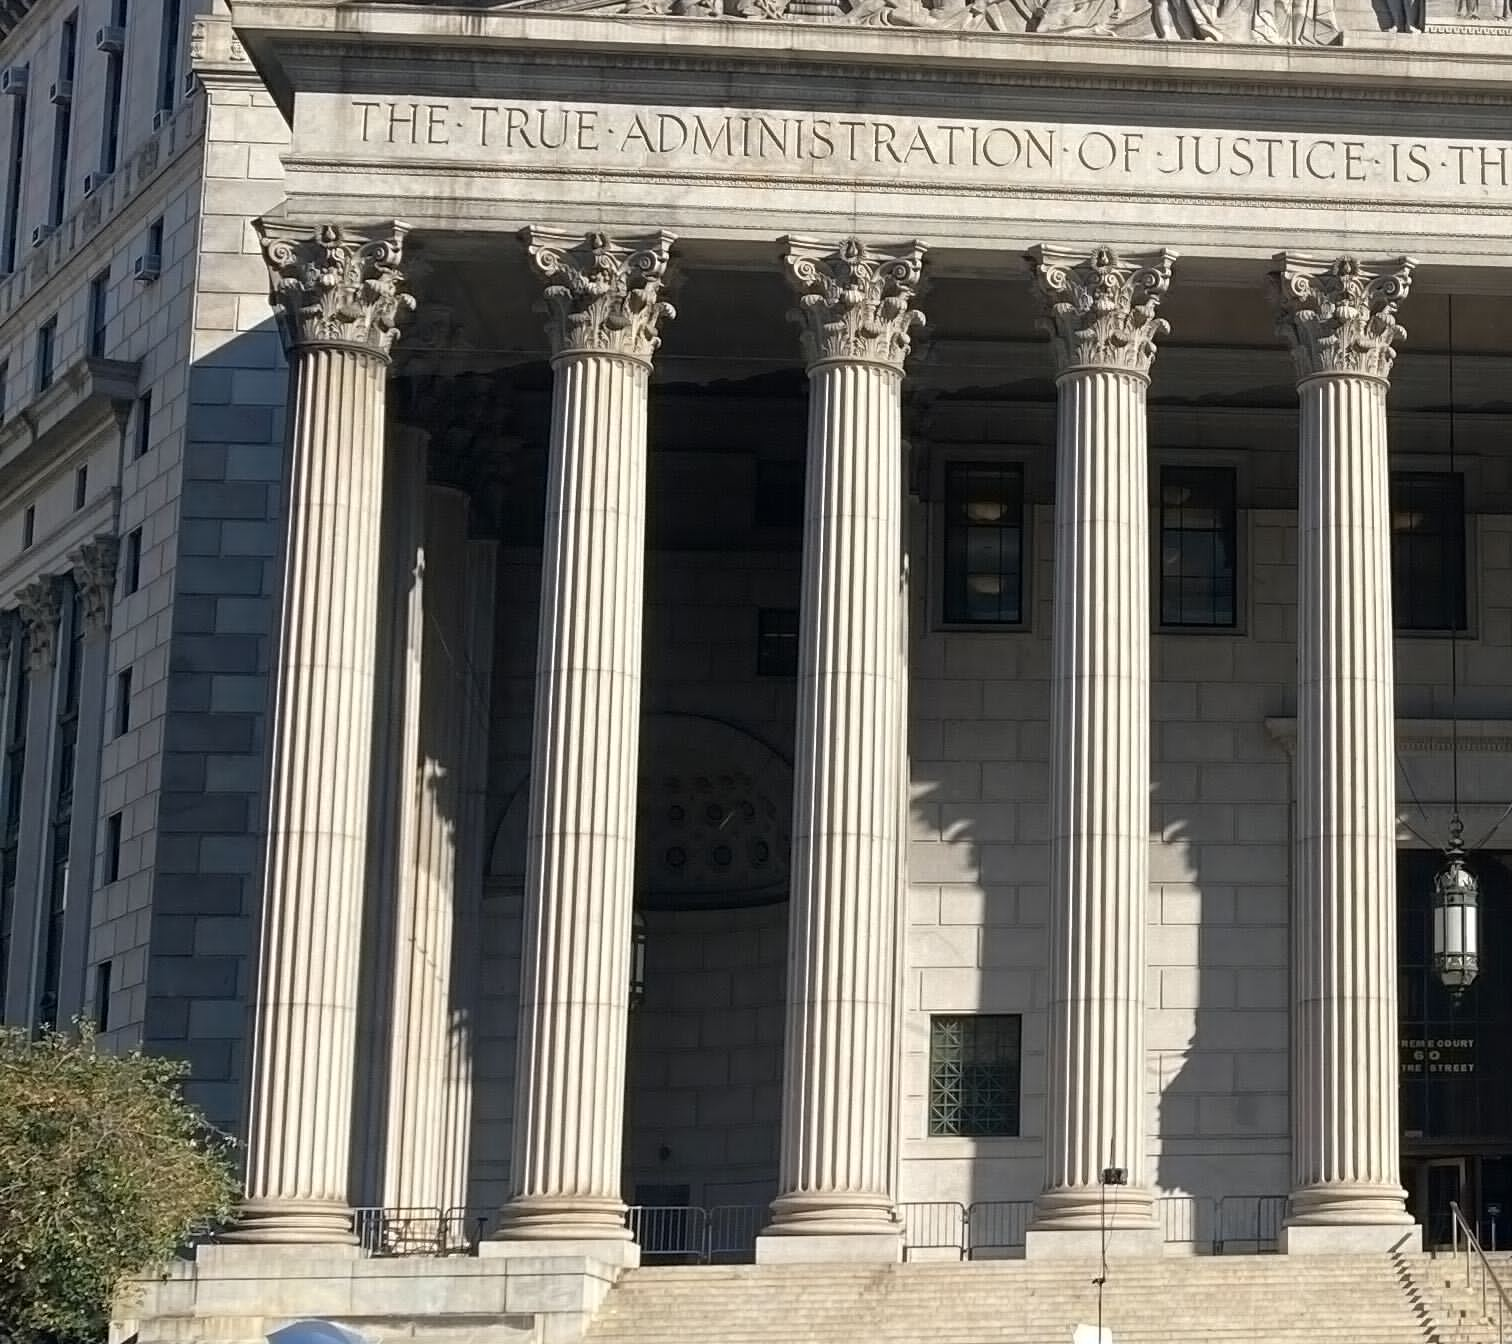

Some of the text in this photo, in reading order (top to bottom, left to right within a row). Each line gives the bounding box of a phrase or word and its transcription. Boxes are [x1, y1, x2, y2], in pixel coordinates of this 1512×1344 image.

[351, 102, 450, 145] THE
[470, 106, 600, 151] TRUE
[618, 112, 1057, 169] ADMINISTRATION
[1078, 131, 1144, 173] OF
[1157, 134, 1367, 183] JUSTICE
[1390, 143, 1431, 183] IS
[1436, 1039, 1475, 1048] COURT
[1430, 1063, 1475, 1073] STREET
